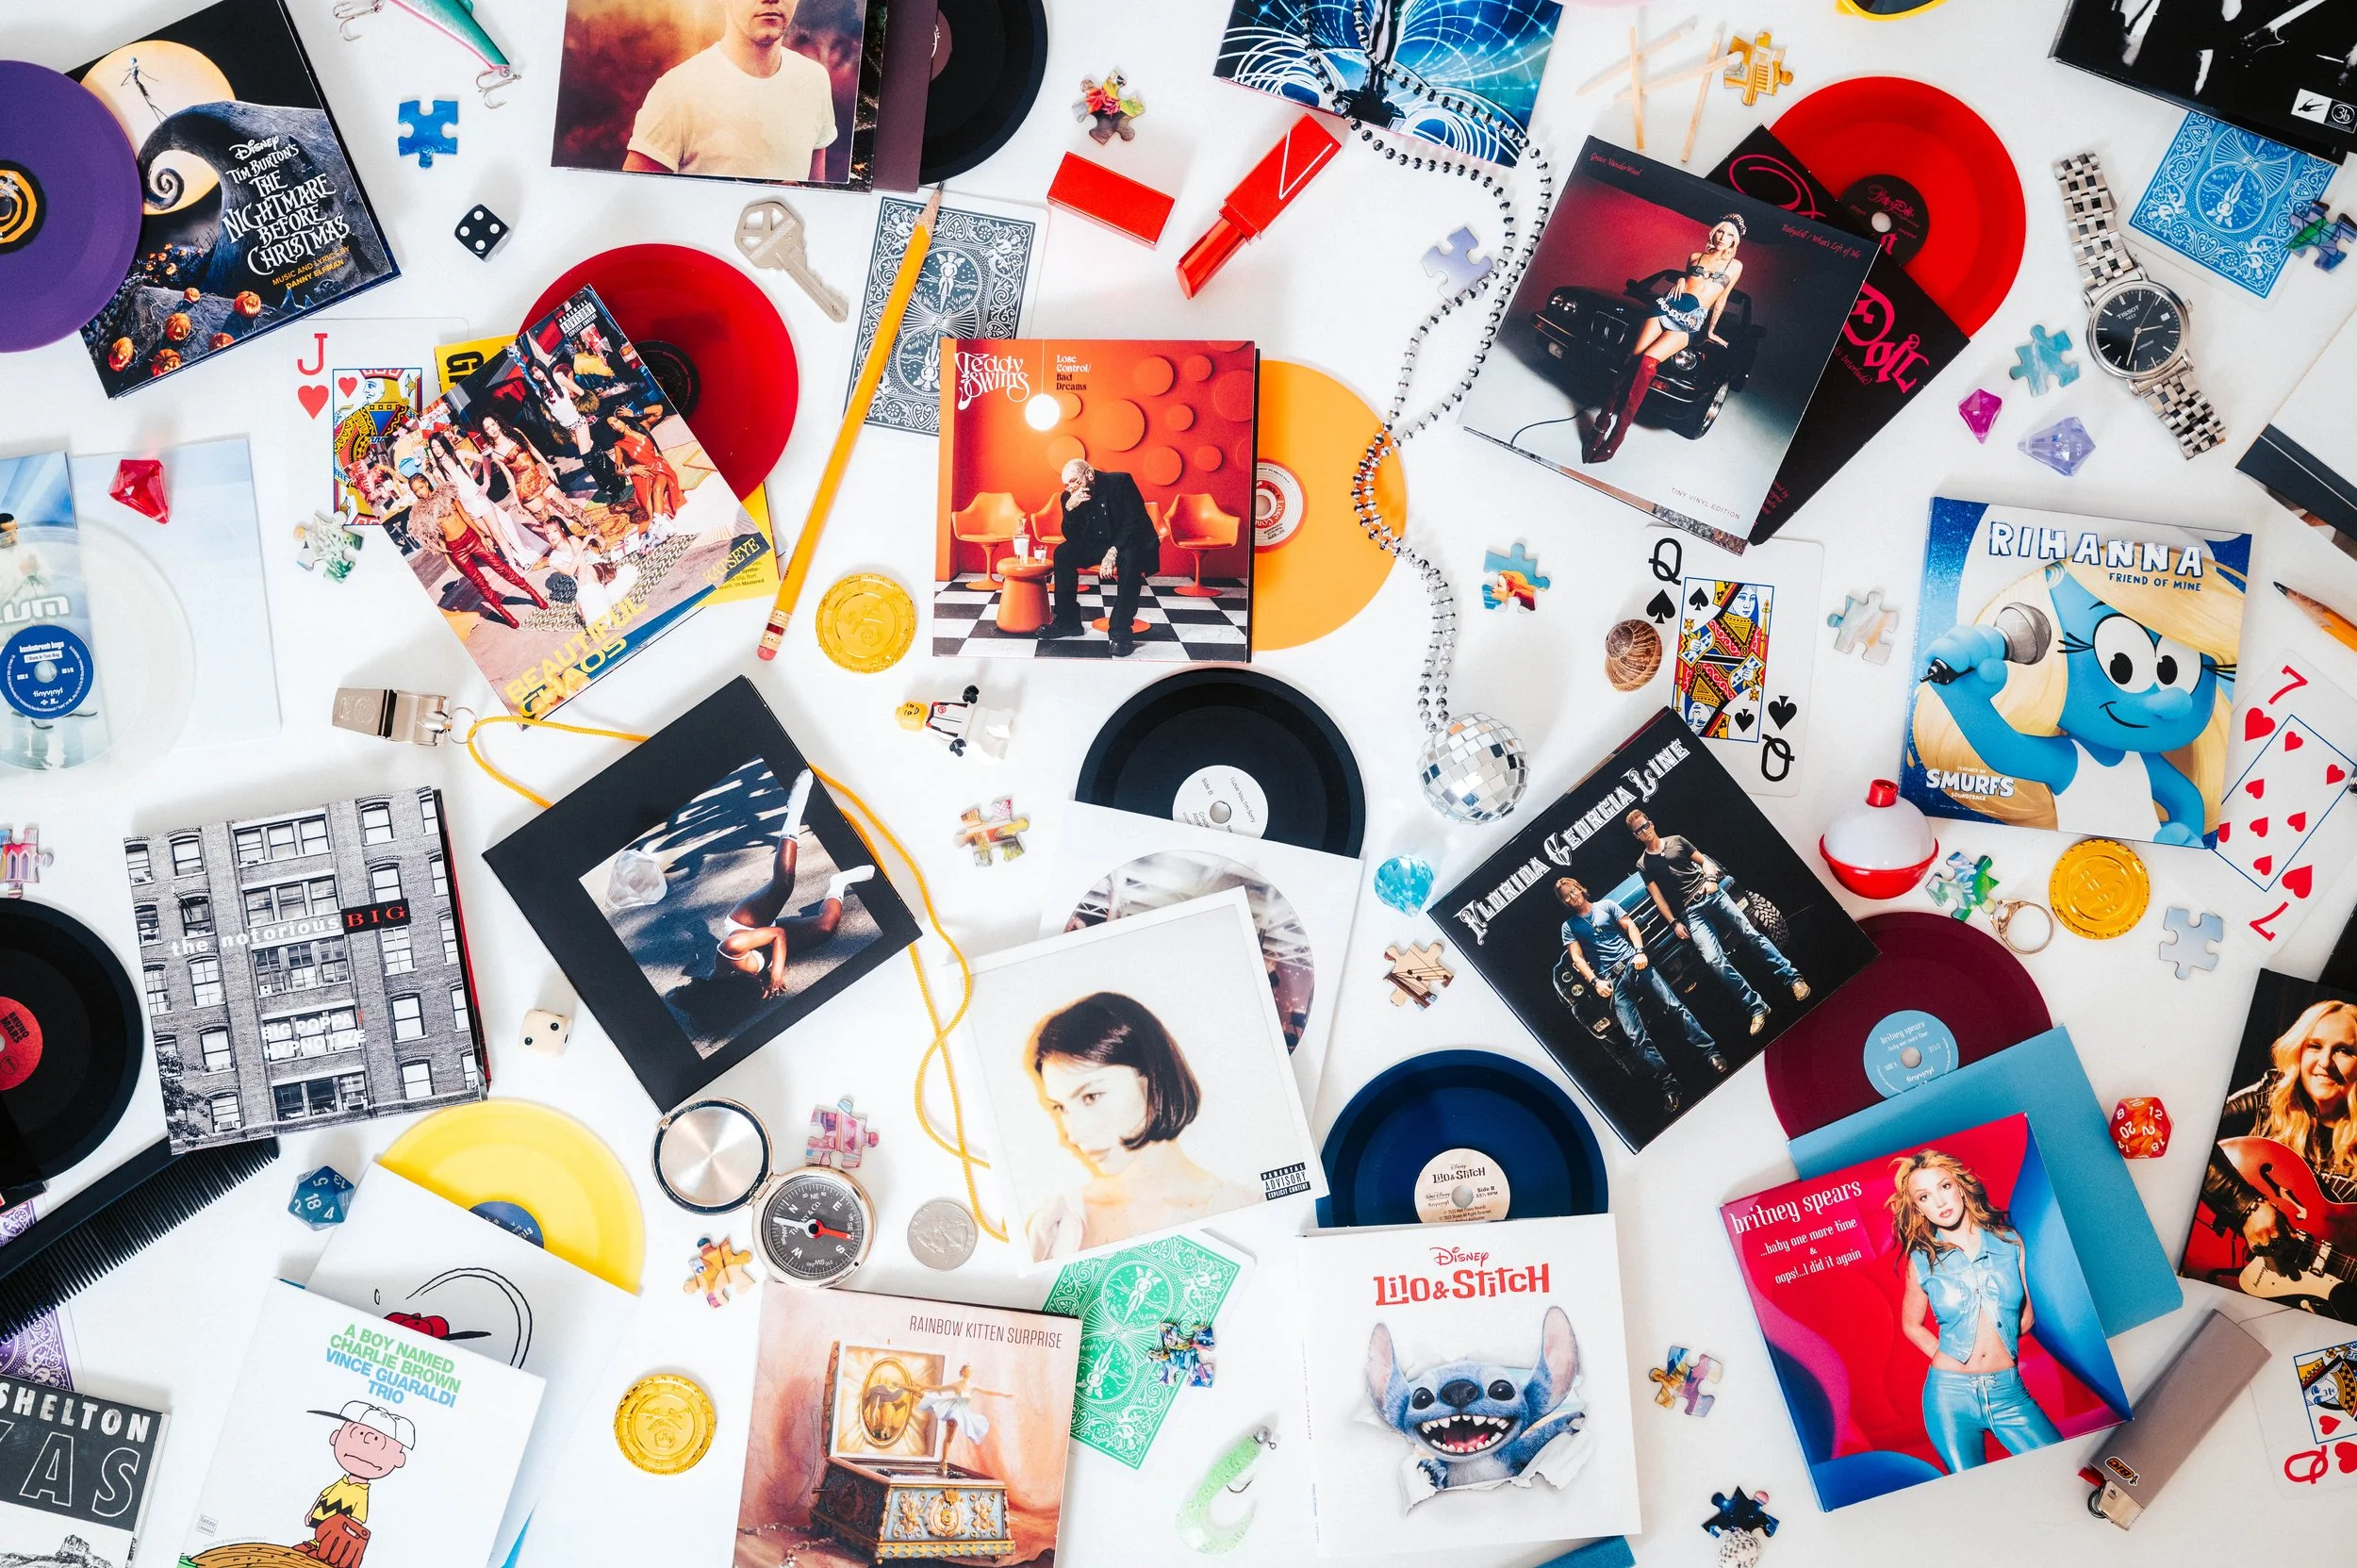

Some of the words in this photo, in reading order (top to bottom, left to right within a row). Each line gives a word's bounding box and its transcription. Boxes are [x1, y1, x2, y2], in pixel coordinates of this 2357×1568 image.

[229, 135, 280, 160] Disney
[249, 170, 288, 198] THE
[222, 173, 337, 243] NIGHTMARE
[256, 204, 327, 248] BEFORE
[247, 212, 350, 275] CHRISTMAS
[272, 271, 297, 286] MUSIC
[297, 262, 313, 274] AND
[313, 252, 338, 268] LYRICS
[339, 245, 351, 256] BY
[286, 274, 313, 290] DANNY
[314, 258, 345, 277] ELFMAN
[562, 303, 594, 332] ADVISORY
[2117, 305, 2139, 319] TISSOT
[297, 333, 328, 376] J
[954, 352, 1024, 375] Teddy
[1056, 354, 1077, 363] Lose
[957, 371, 1030, 411] Swims
[1056, 373, 1073, 382] Bad
[1056, 382, 1087, 391] Dreams
[1671, 487, 1687, 498] TINY
[1689, 493, 1708, 507] VINYL
[1711, 503, 1741, 520] EDITION
[701, 537, 761, 584] KATSEYE
[1648, 537, 1682, 586] Q
[1988, 520, 2204, 578] RIHANNA
[2109, 572, 2149, 586] FRIEND
[2153, 578, 2168, 587] OF
[2173, 581, 2201, 592] MINE
[503, 597, 649, 705] BEAUTIFUL
[519, 632, 627, 718] CHAOS
[2267, 664, 2309, 705] 7
[33, 686, 64, 698] tinyvinyl
[1761, 734, 1795, 783] Q
[1201, 777, 1211, 791] Side
[1926, 768, 2015, 798] SMURFS
[1951, 792, 1986, 801] SOUNDTRACK
[1231, 780, 1240, 792] Love
[1246, 809, 1257, 823] Sorry
[1453, 856, 1552, 946] FLORIDA
[1543, 785, 1638, 867] GEORGIA
[1620, 738, 1691, 803] LINE
[170, 939, 208, 957] the
[222, 915, 340, 949] notorious
[346, 905, 406, 929] BIG
[2249, 900, 2290, 942] 7
[1, 1015, 23, 1044] MARS
[8, 1011, 30, 1038] BRUNO
[261, 1022, 292, 1039] BIG
[295, 1012, 354, 1033] POPPA
[1879, 1030, 1904, 1045] britney
[1904, 1021, 1926, 1034] spears
[263, 1030, 365, 1059] HYPNOTIZE
[2117, 1108, 2125, 1120] 8
[2149, 1105, 2164, 1121] 12
[2118, 1120, 2136, 1139] 20
[2141, 1125, 2156, 1136] 2
[2151, 1138, 2166, 1152] 18
[313, 1177, 329, 1187] 5
[333, 1174, 346, 1189] 13
[1262, 1164, 1304, 1180] PARENTAL
[1265, 1171, 1307, 1191] ADVISORY
[1267, 1188, 1289, 1199] EXPLICIT
[1288, 1182, 1309, 1194] CONTENT
[294, 1198, 302, 1214] 2
[305, 1193, 322, 1211] 18
[323, 1206, 335, 1220] 4
[788, 1204, 799, 1214] N
[832, 1201, 843, 1212] E
[1729, 1200, 1802, 1235] britney
[1802, 1180, 1863, 1215] spears
[847, 1222, 854, 1231] SE
[1760, 1239, 1790, 1257] ...baby
[1790, 1234, 1808, 1247] one
[1808, 1226, 1835, 1241] more
[1834, 1218, 1858, 1233] time
[791, 1246, 803, 1260] W
[835, 1245, 846, 1255] S
[1428, 1246, 1490, 1267] Disney
[1809, 1246, 1818, 1255] &
[1809, 1257, 1824, 1274] did
[1824, 1255, 1835, 1268] it
[1836, 1247, 1863, 1266] again
[1432, 1280, 1450, 1300] &
[909, 1315, 964, 1337] RAINBOW
[965, 1322, 1005, 1342] KITTEN
[1007, 1327, 1063, 1349] SURPRISE
[344, 1323, 355, 1339] A
[359, 1328, 395, 1352] BOY
[396, 1342, 455, 1374] NAMED
[330, 1334, 399, 1371] CHARLIE
[400, 1360, 462, 1394] BROWN
[325, 1347, 373, 1378] VINCE
[375, 1367, 457, 1409] GUARALDI
[368, 1379, 404, 1405] TRIO
[0, 1381, 151, 1444] SHELTON
[2107, 1460, 2133, 1478] BIC
[2283, 1444, 2329, 1485] Q
